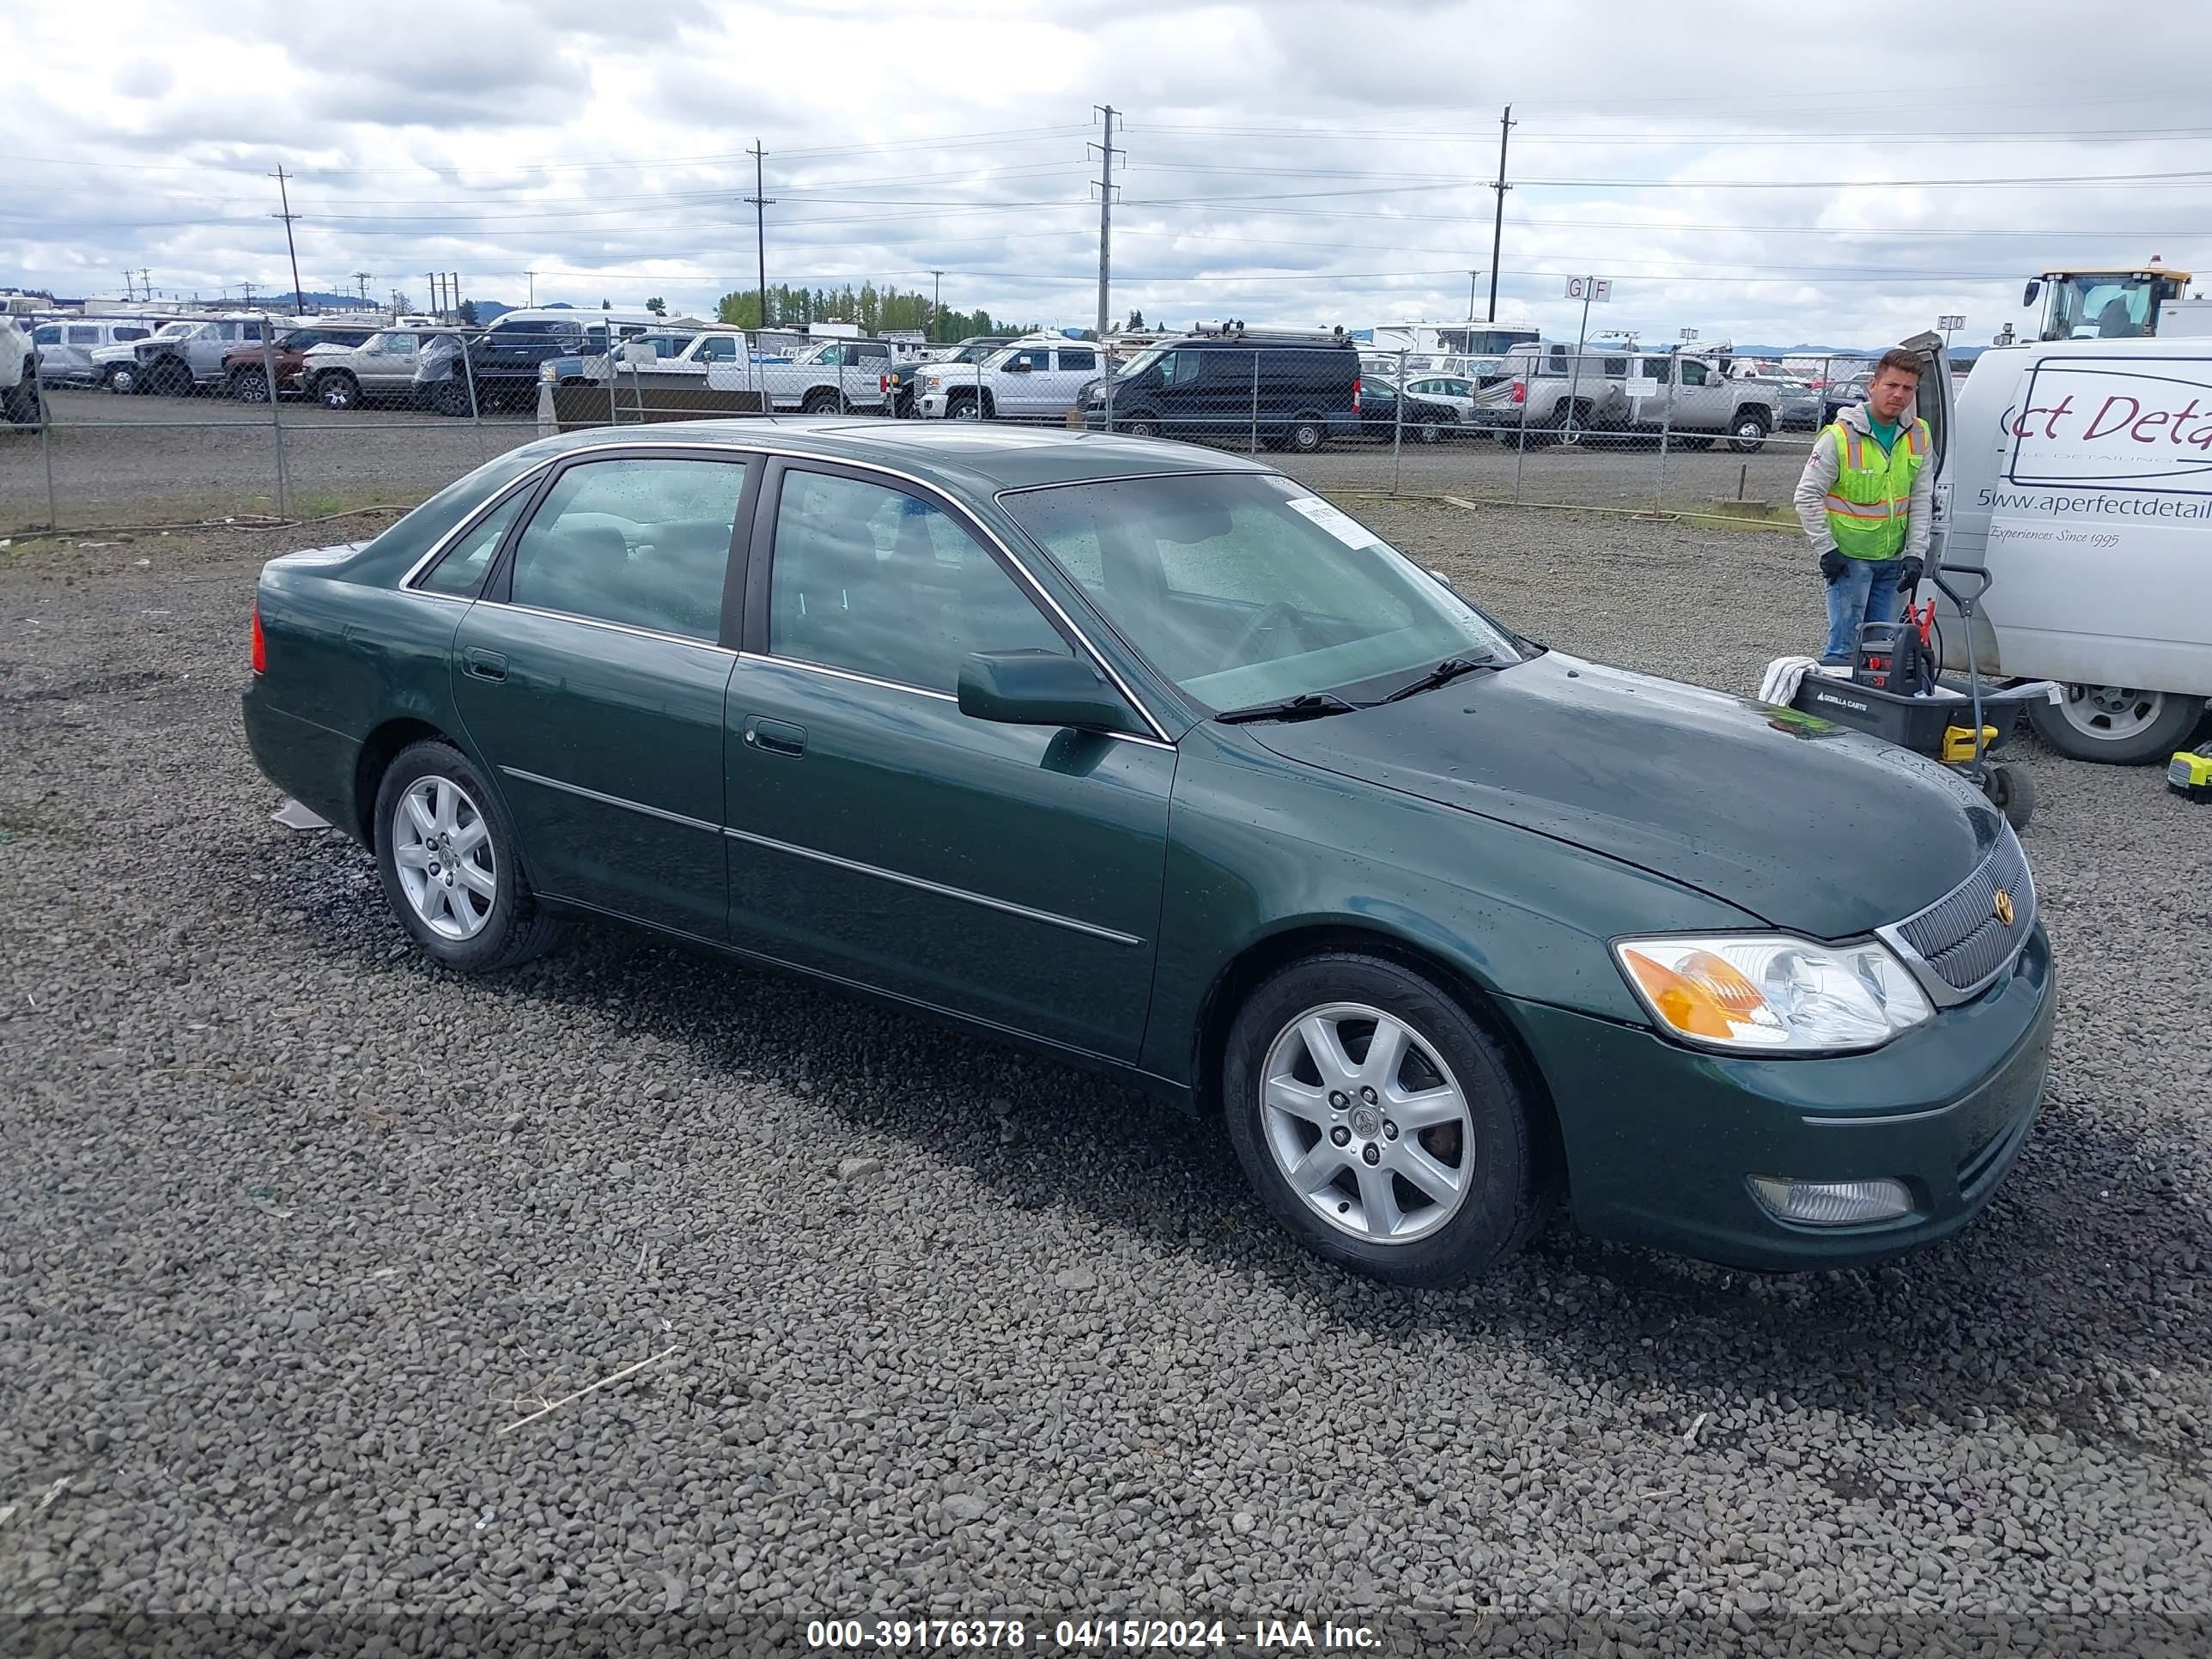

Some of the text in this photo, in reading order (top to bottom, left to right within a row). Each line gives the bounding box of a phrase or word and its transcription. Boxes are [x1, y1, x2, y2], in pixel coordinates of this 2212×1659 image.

[1569, 278, 1607, 300] G F
[1940, 317, 1963, 329] E D
[1989, 525, 2121, 549] Experiences Since 1995
[1824, 694, 1868, 712] GORILLA CARTS
